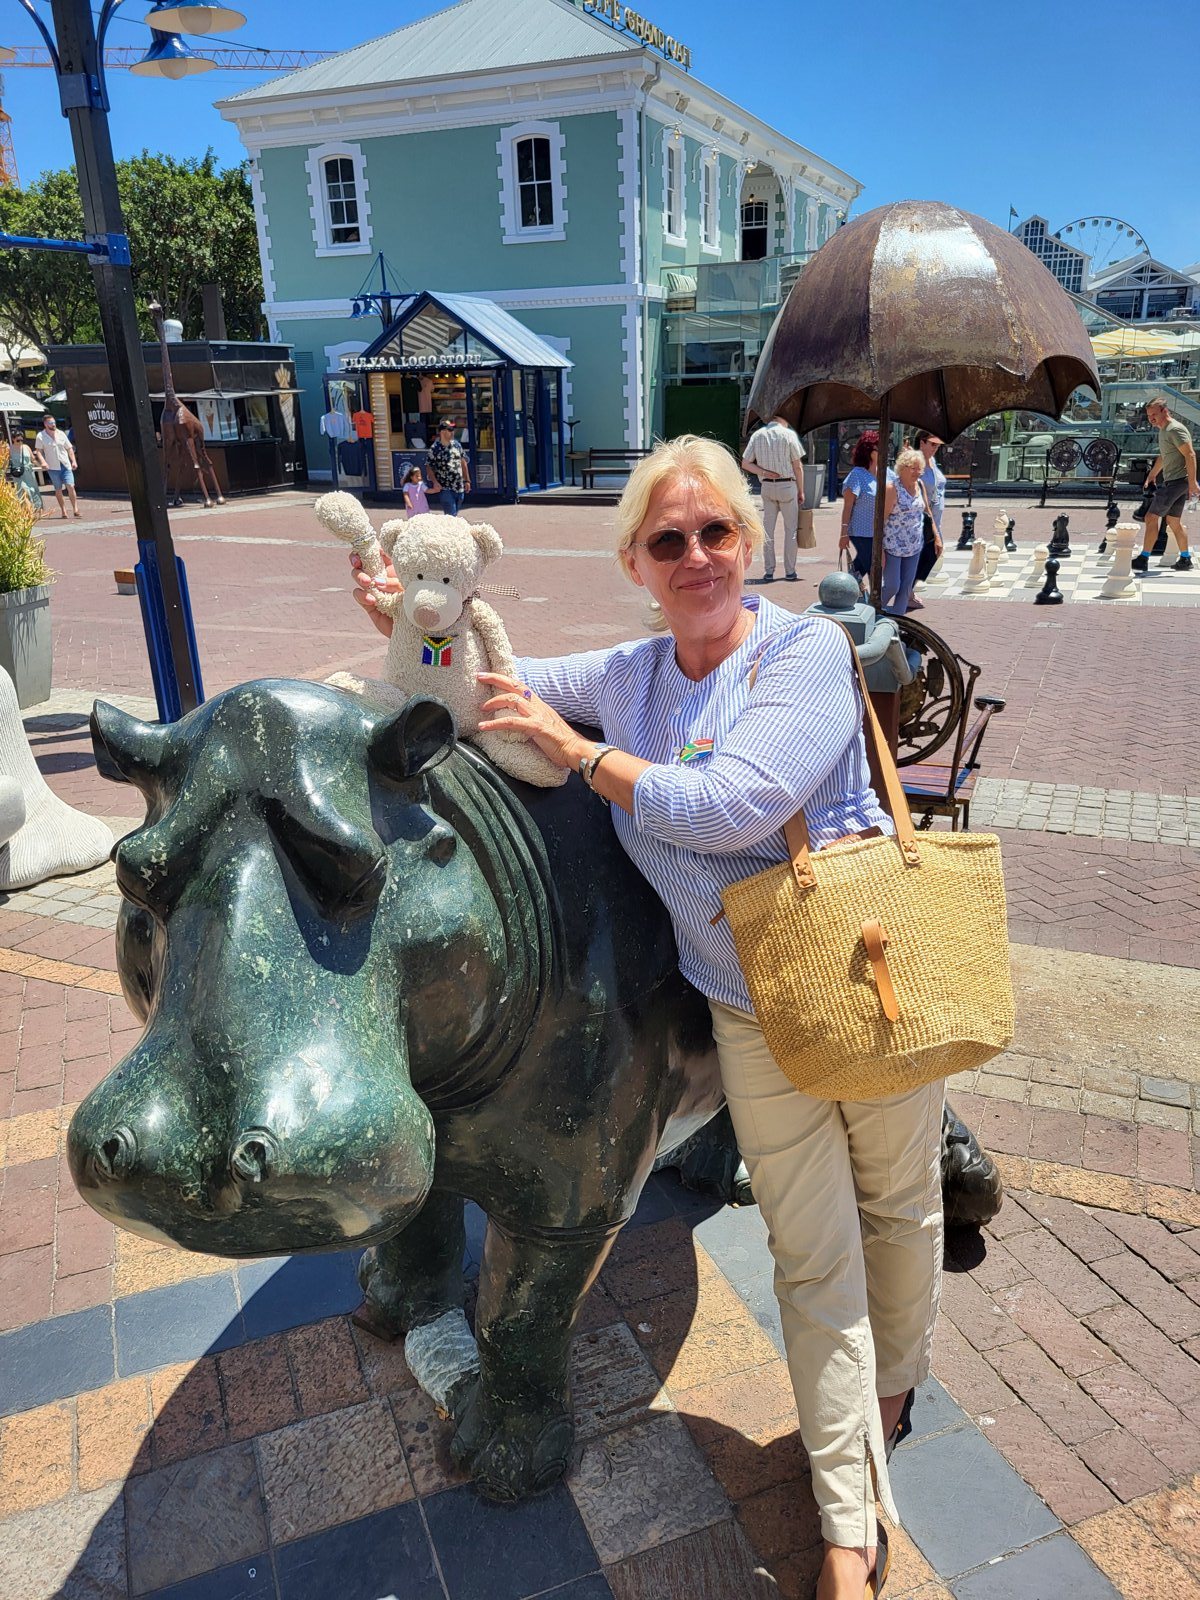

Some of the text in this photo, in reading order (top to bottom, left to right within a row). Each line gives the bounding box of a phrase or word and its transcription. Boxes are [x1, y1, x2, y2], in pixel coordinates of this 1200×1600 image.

[624, 7, 665, 50] GRAND
[341, 354, 482, 368] THE V&A LOGO STORE
[87, 409, 115, 421] HOT DOG
